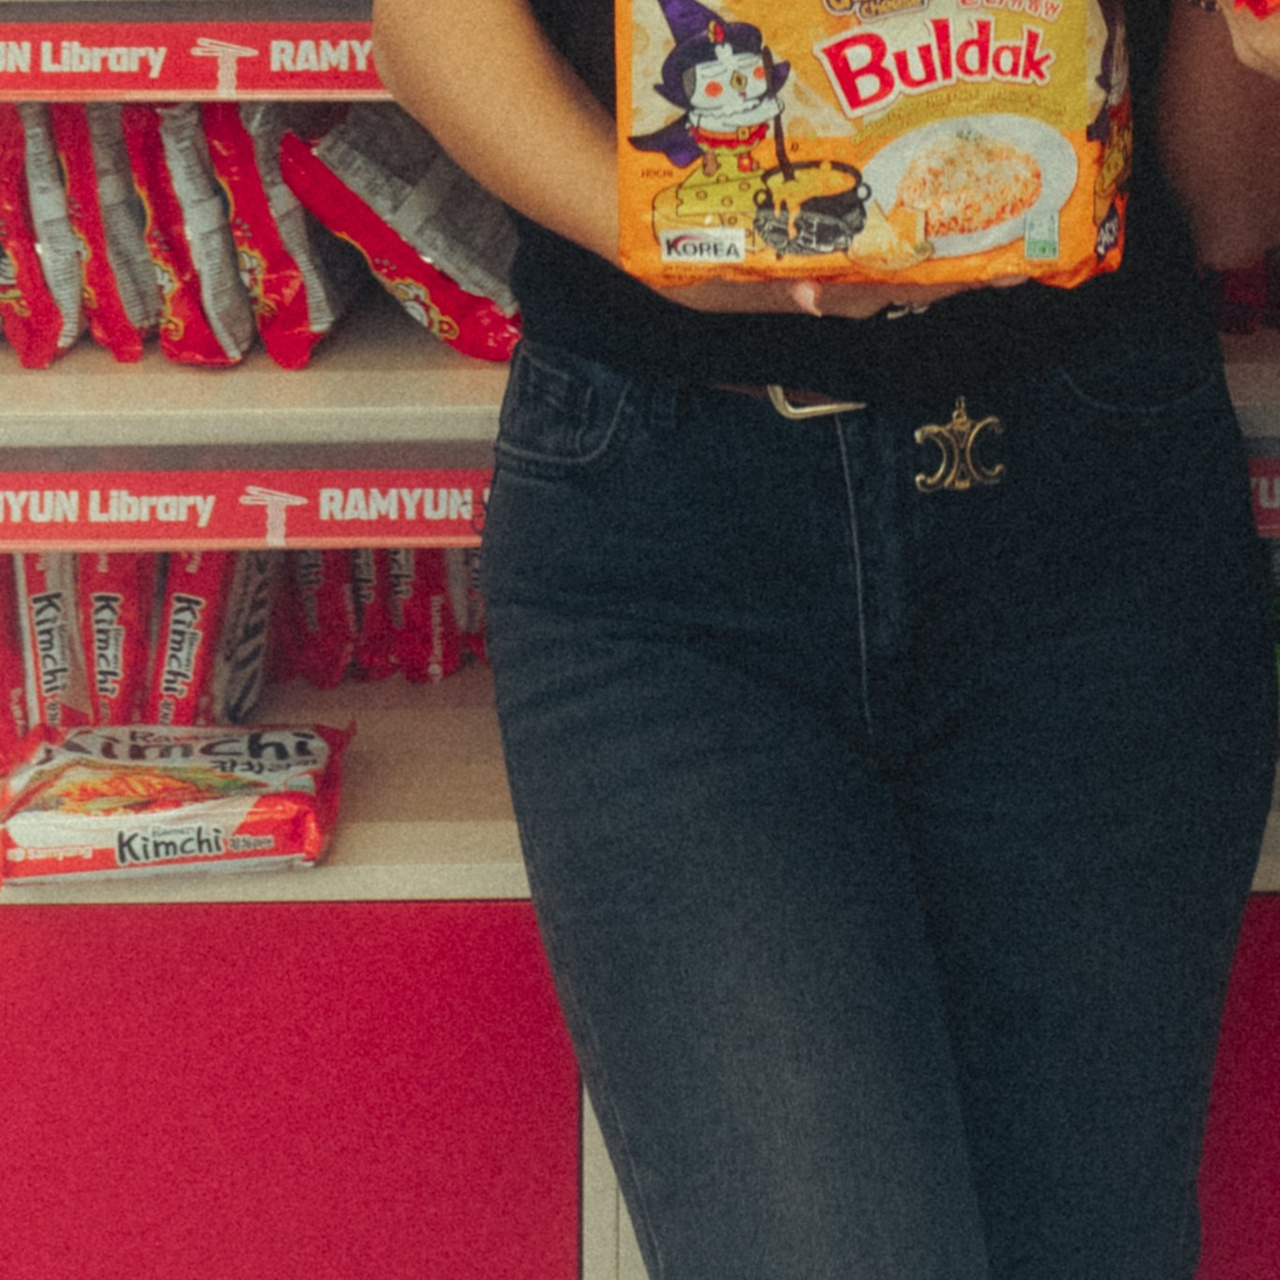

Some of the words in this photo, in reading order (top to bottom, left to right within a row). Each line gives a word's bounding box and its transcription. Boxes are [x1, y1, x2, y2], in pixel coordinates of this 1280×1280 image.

[40, 41, 167, 79] Library
[821, 17, 1051, 112] Buldak
[665, 237, 741, 258] KOREA
[88, 490, 216, 528] Library
[319, 487, 472, 521] RAMYUN
[31, 591, 69, 695] Kimchi
[92, 594, 121, 696] Kimchi
[161, 594, 204, 697] Kimchi
[116, 827, 224, 865] Kimchi
